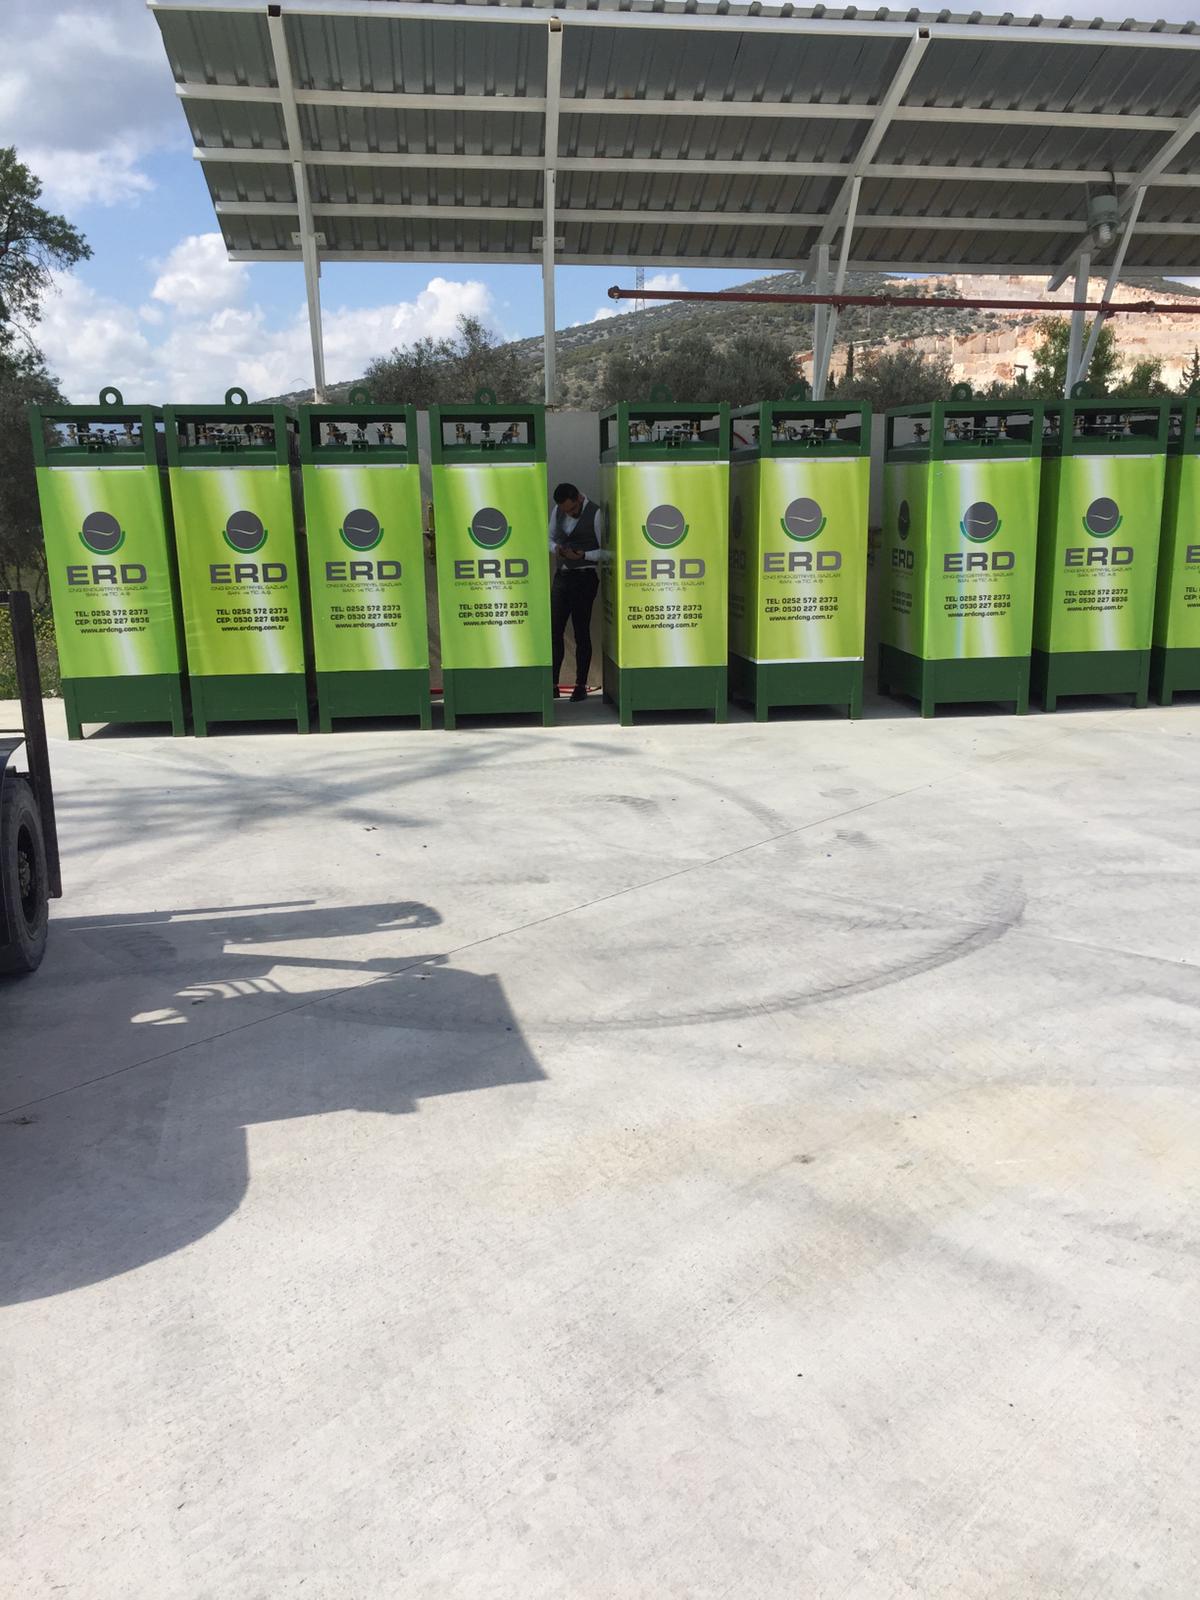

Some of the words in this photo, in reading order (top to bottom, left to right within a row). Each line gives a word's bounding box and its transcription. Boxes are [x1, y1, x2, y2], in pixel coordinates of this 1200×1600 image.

[764, 551, 841, 572] ERD
[944, 552, 1014, 572] ERD
[1065, 547, 1134, 566] ERD
[67, 564, 148, 585] ERD
[209, 563, 288, 583] ERD
[326, 561, 402, 580] ERD
[454, 559, 529, 579] ERD
[626, 559, 705, 579] ERD
